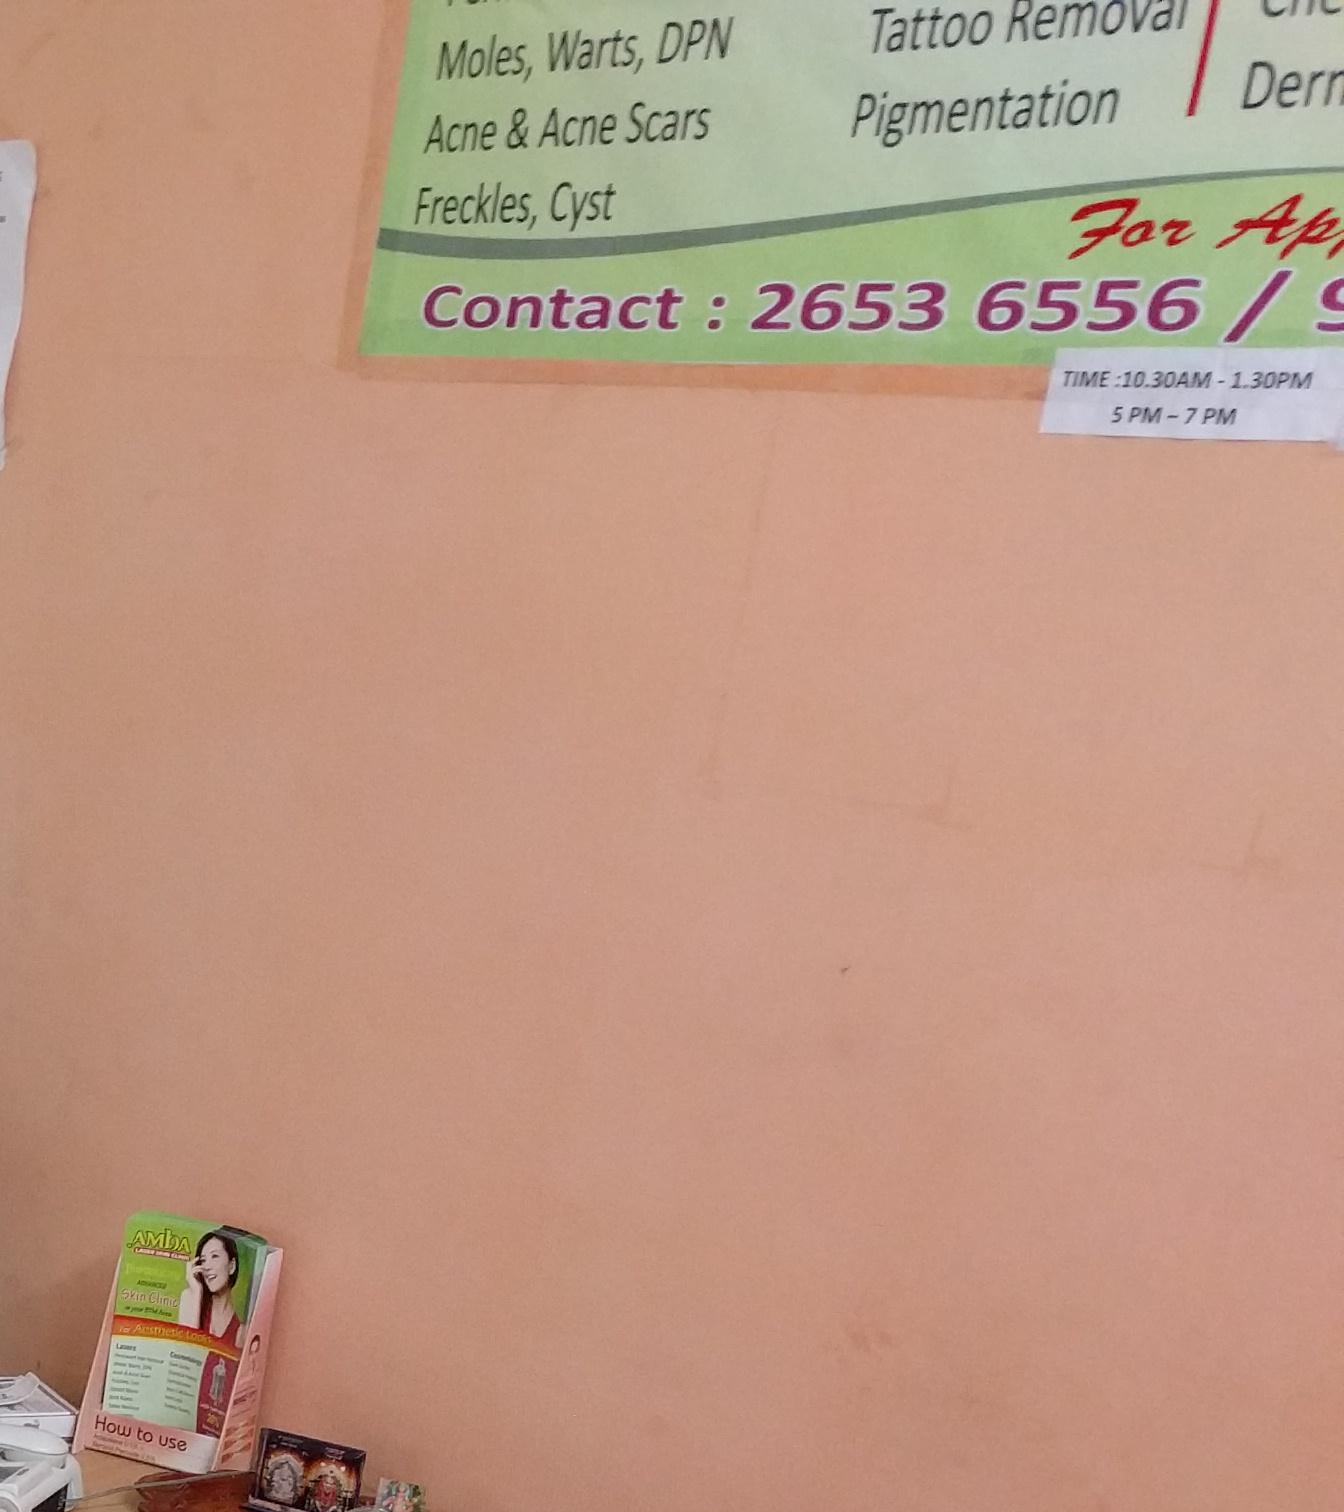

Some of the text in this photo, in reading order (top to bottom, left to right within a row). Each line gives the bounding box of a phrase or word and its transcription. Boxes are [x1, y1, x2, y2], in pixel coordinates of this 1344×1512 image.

[435, 15, 735, 83] Moles, Warts, DPN
[871, 0, 1189, 54] Tattoo Removal
[423, 100, 713, 154] Acne & Acne Scars
[850, 78, 1121, 148] Pigmentation
[414, 181, 618, 232] Freckles, Cyst
[1068, 192, 1344, 260] For Ap
[423, 283, 683, 331] Contact
[749, 280, 948, 332] 2653
[974, 277, 1203, 333] 6556
[1223, 270, 1294, 343] /
[1062, 370, 1111, 388] TIME
[1231, 371, 1314, 390] 1.30PM
[1111, 406, 1123, 424] 5
[1127, 407, 1163, 424] PM
[1184, 408, 1196, 424] 7
[1201, 408, 1237, 425] PM
[94, 1414, 132, 1438] How
[137, 1426, 153, 1443] to
[159, 1435, 188, 1452] use
